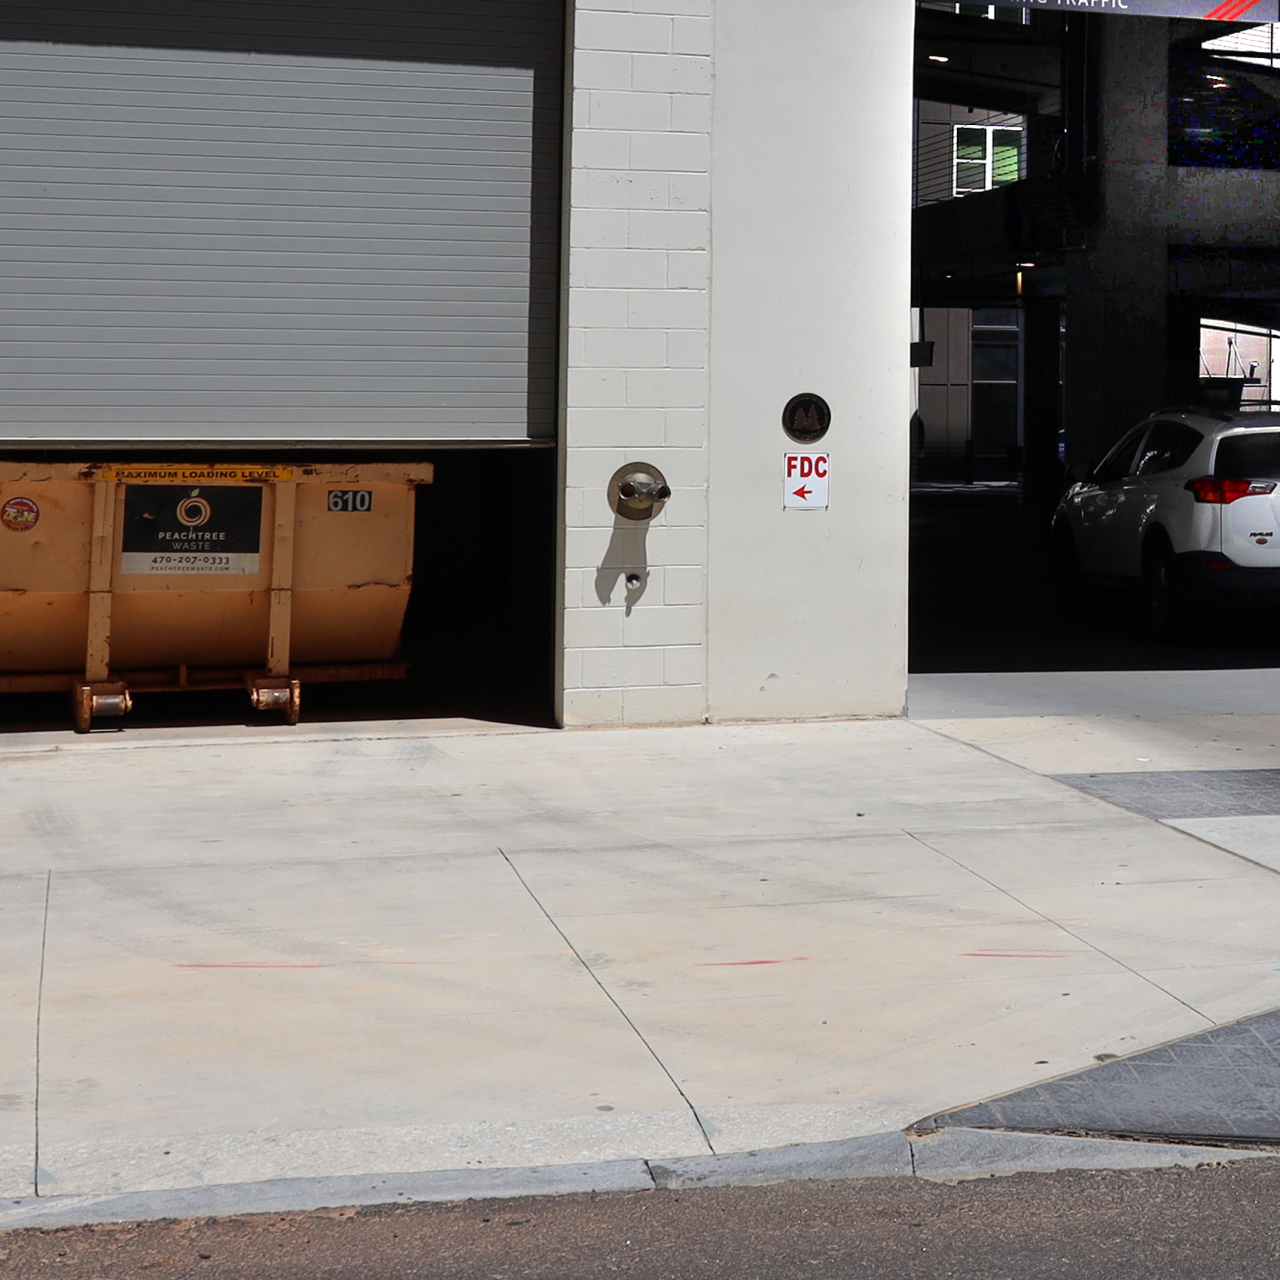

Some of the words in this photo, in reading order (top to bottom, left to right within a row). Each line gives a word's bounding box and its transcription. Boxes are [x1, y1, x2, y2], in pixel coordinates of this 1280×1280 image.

[787, 456, 828, 478] FDC
[115, 470, 178, 479] MAXIMUM
[182, 470, 238, 479] LOADING
[241, 470, 280, 479] LEVEL
[329, 491, 370, 511] 610
[158, 530, 226, 540] PEACHTREE
[171, 541, 211, 550] WASTE
[151, 555, 230, 565] 470-207-0333
